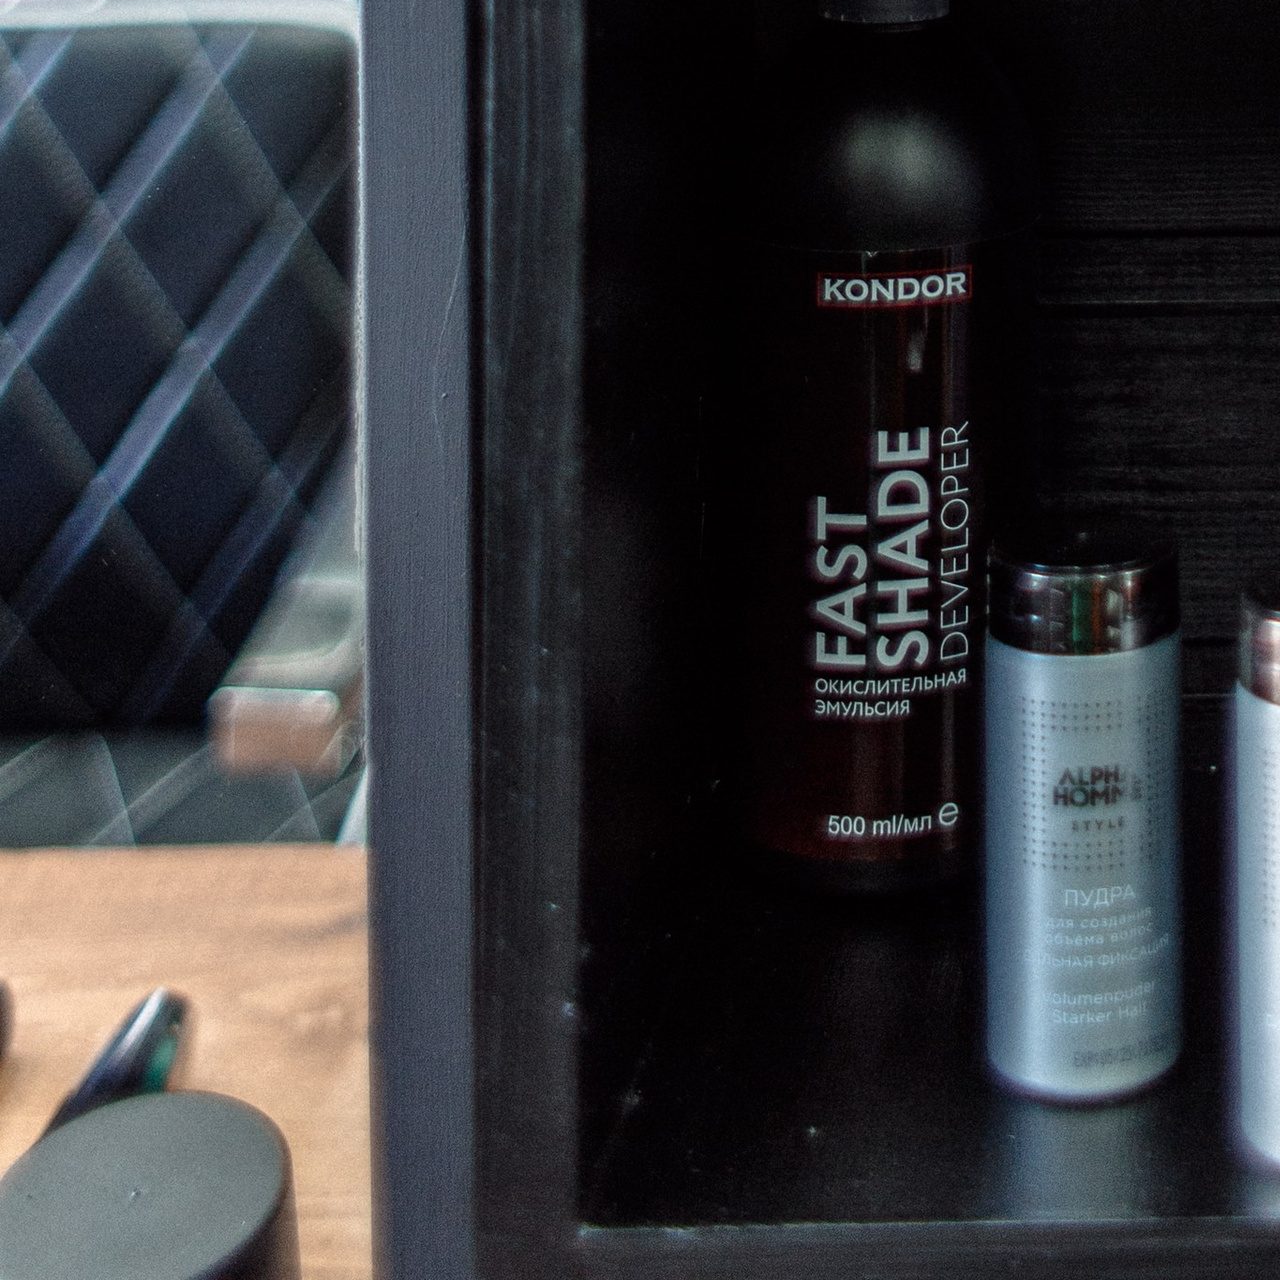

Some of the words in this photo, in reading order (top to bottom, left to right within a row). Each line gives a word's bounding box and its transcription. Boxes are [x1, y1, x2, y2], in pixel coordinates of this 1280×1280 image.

[823, 271, 967, 302] KONDOR
[877, 427, 930, 667] SHADE
[940, 421, 969, 661] DEVELOPER
[816, 496, 868, 666] FAST
[815, 668, 966, 695] ОКИСЛИТЕЛЬНАЯ
[815, 699, 911, 717] ЭМУЛЬСИЯ
[1058, 764, 1124, 786] ALPH
[829, 814, 866, 835] 500
[1071, 816, 1124, 832] STYLE
[1065, 884, 1136, 909] ПУДРА
[1080, 906, 1152, 928] создания
[1111, 922, 1154, 943] волос
[1052, 1009, 1111, 1025] Starker
